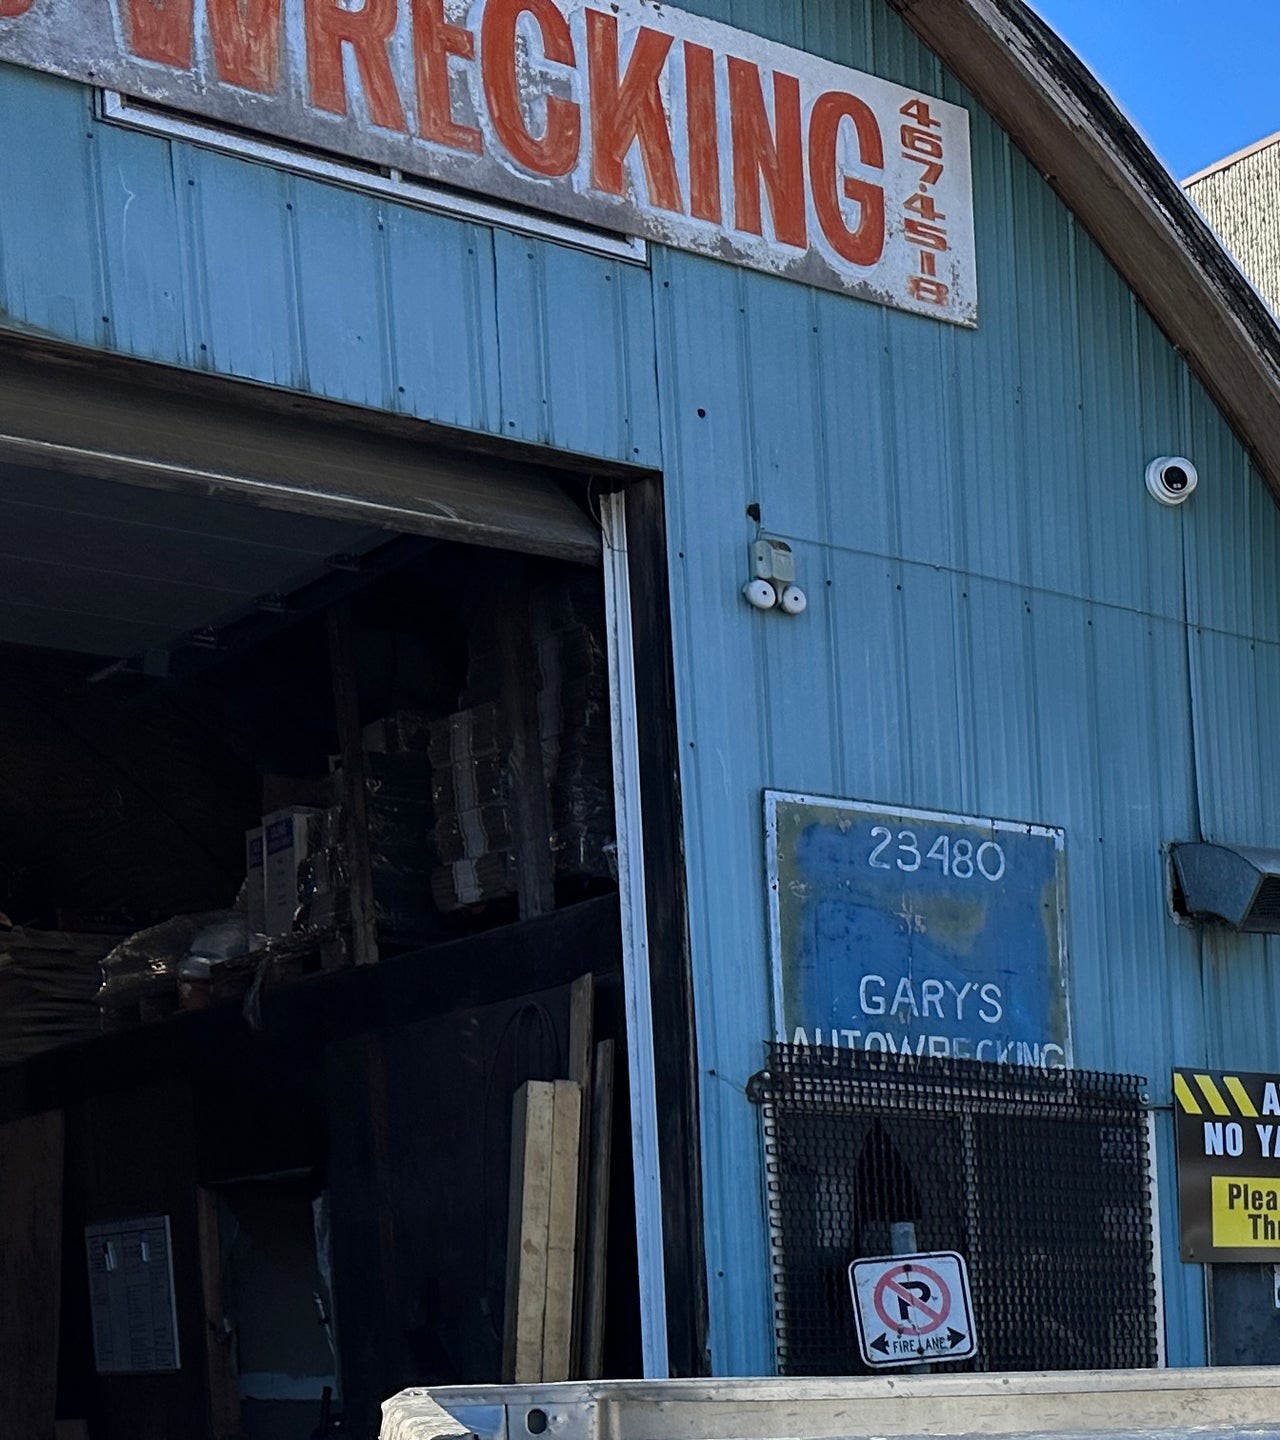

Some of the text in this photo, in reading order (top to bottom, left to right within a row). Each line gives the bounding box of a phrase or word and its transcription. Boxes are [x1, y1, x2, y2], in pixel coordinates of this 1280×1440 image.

[868, 826, 1005, 881] 23480
[859, 974, 1002, 1023] GARY'S
[1204, 1122, 1244, 1157] NO
[892, 1339, 916, 1354] FIRE
